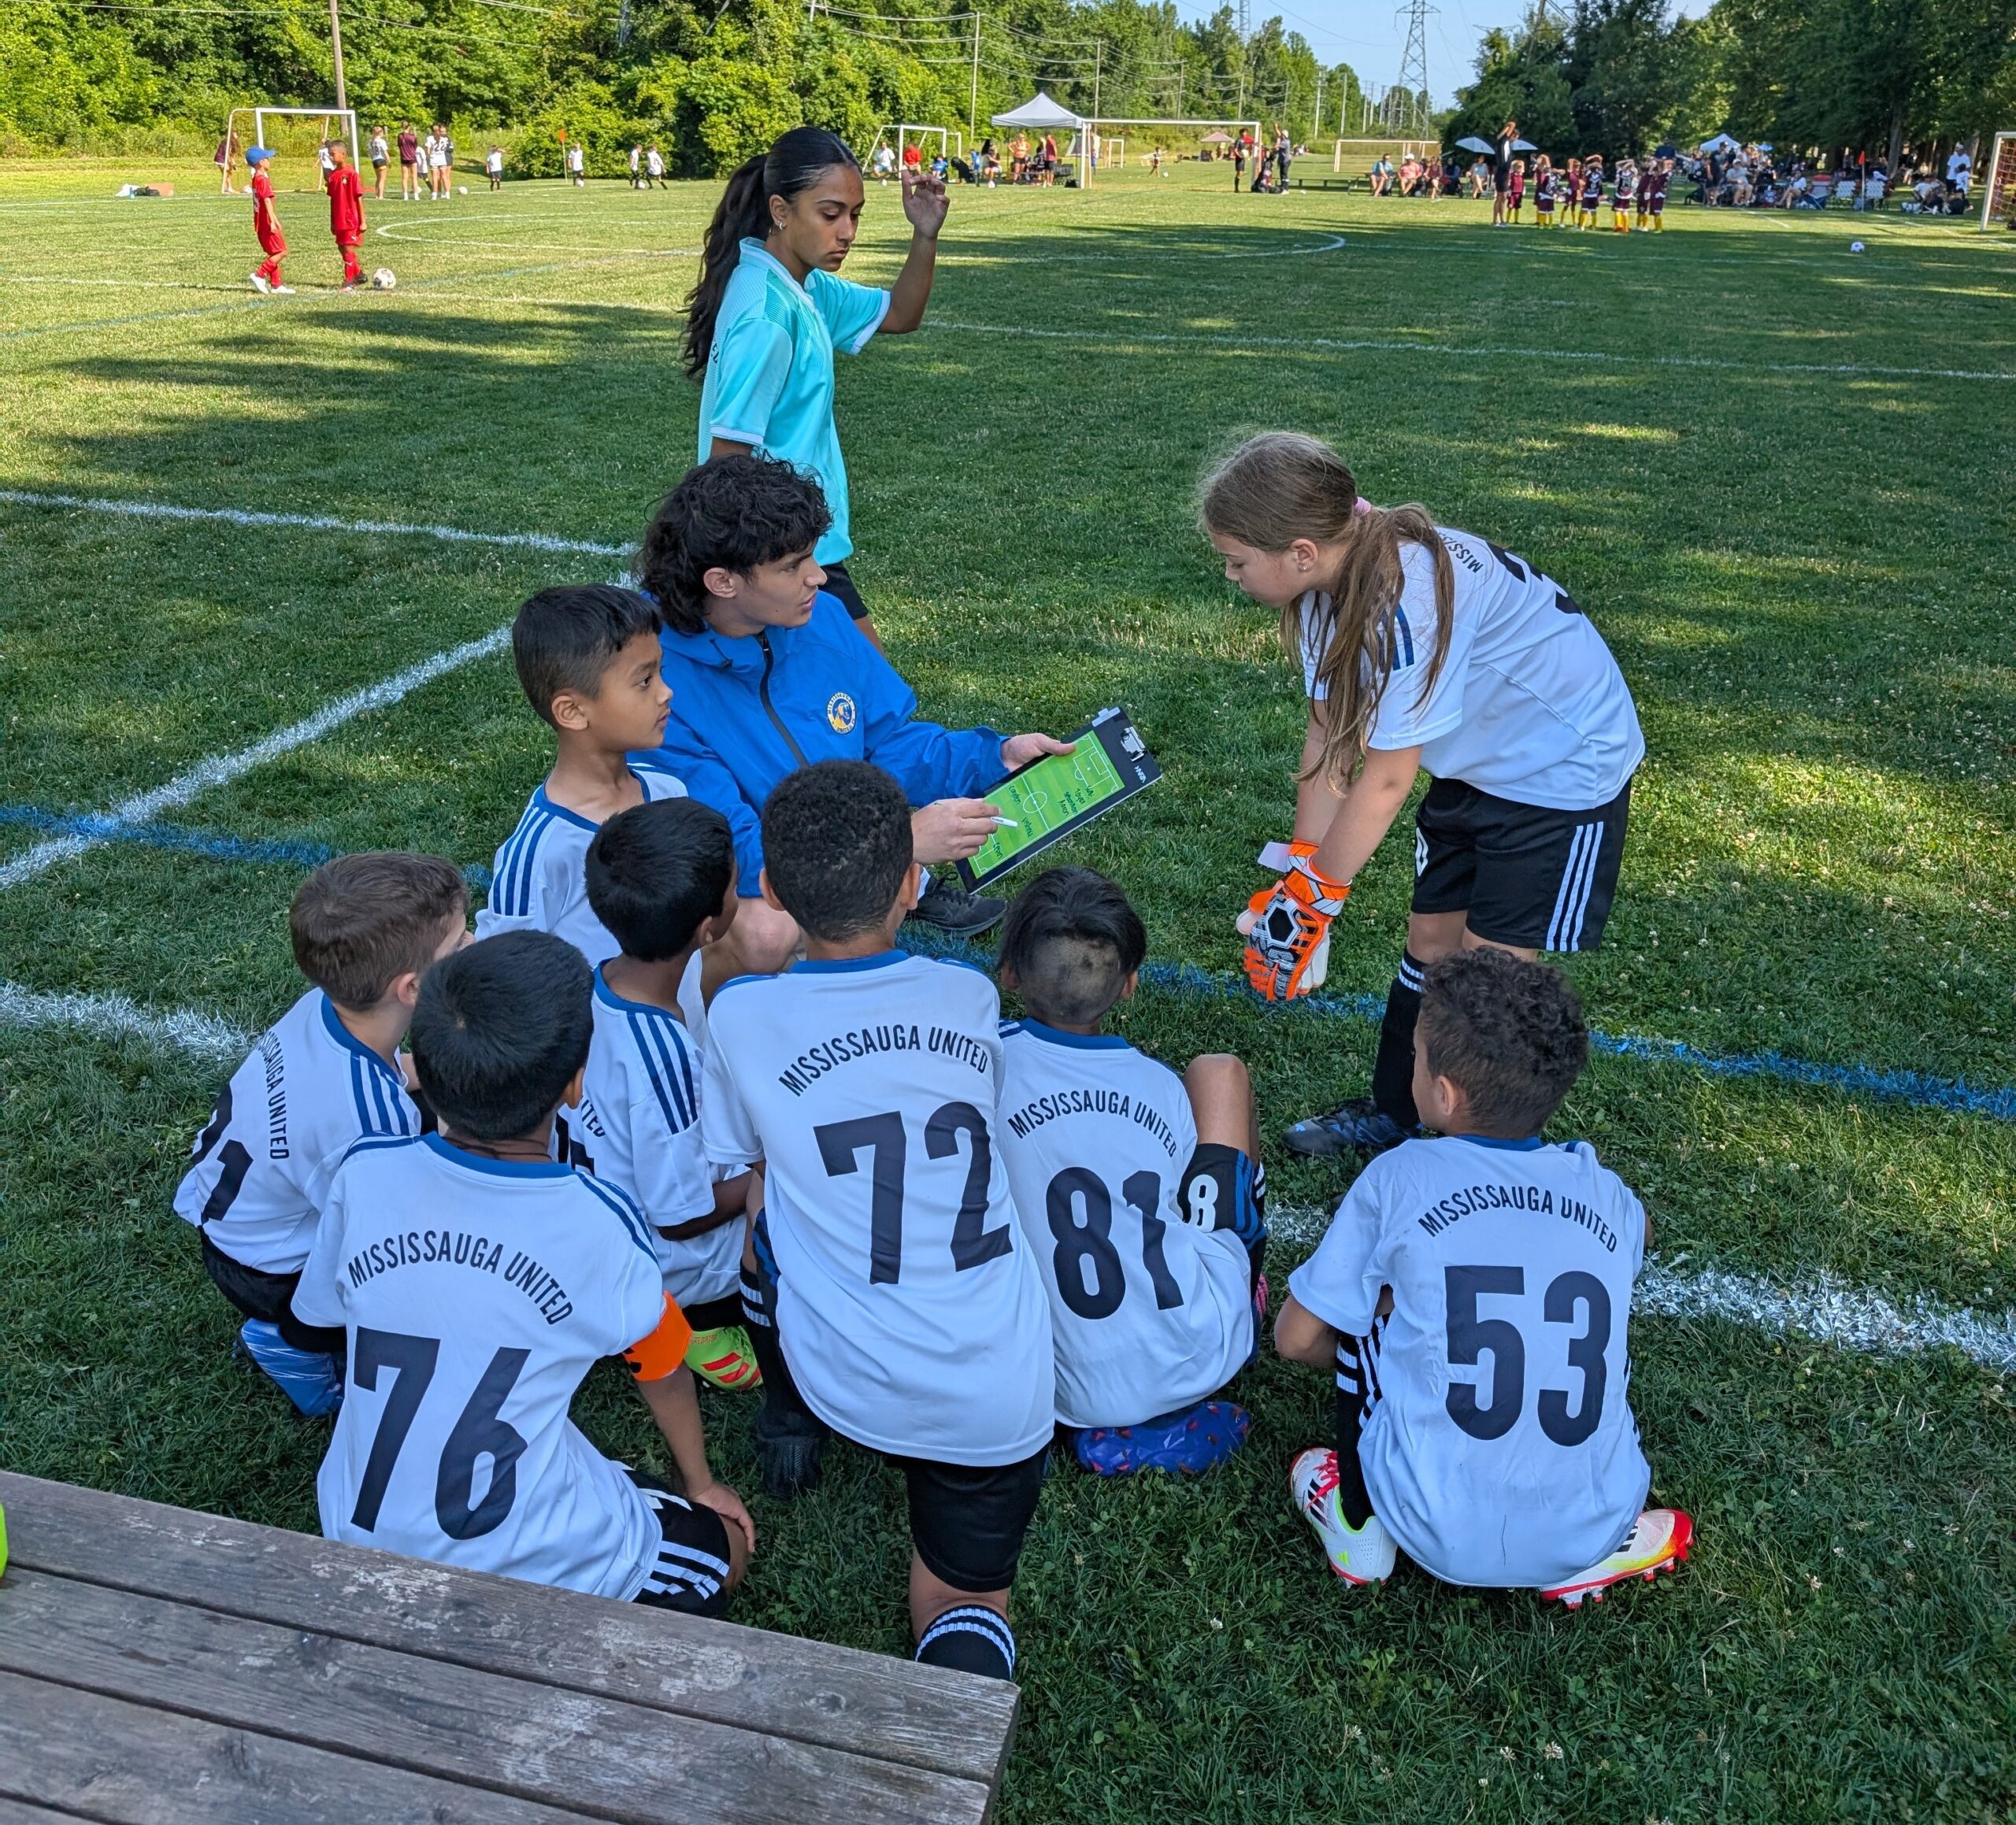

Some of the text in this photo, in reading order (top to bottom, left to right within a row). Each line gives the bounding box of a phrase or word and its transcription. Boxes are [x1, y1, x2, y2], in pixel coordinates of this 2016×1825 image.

[778, 1024, 988, 1097] MISSISSAUGA UNITED
[267, 1090, 289, 1160] UNITED
[1008, 1090, 1177, 1158] MISSISSAUGA UNITED
[813, 1101, 1014, 1284] 72
[1188, 1174, 1218, 1233] 8
[1418, 1185, 1618, 1253] MISSISSAUGA UNITED
[348, 1231, 573, 1325] MISSISSAUGA UNITED
[1046, 1167, 1184, 1320] 81
[1444, 1265, 1611, 1447] 53
[351, 1325, 532, 1540] 76
